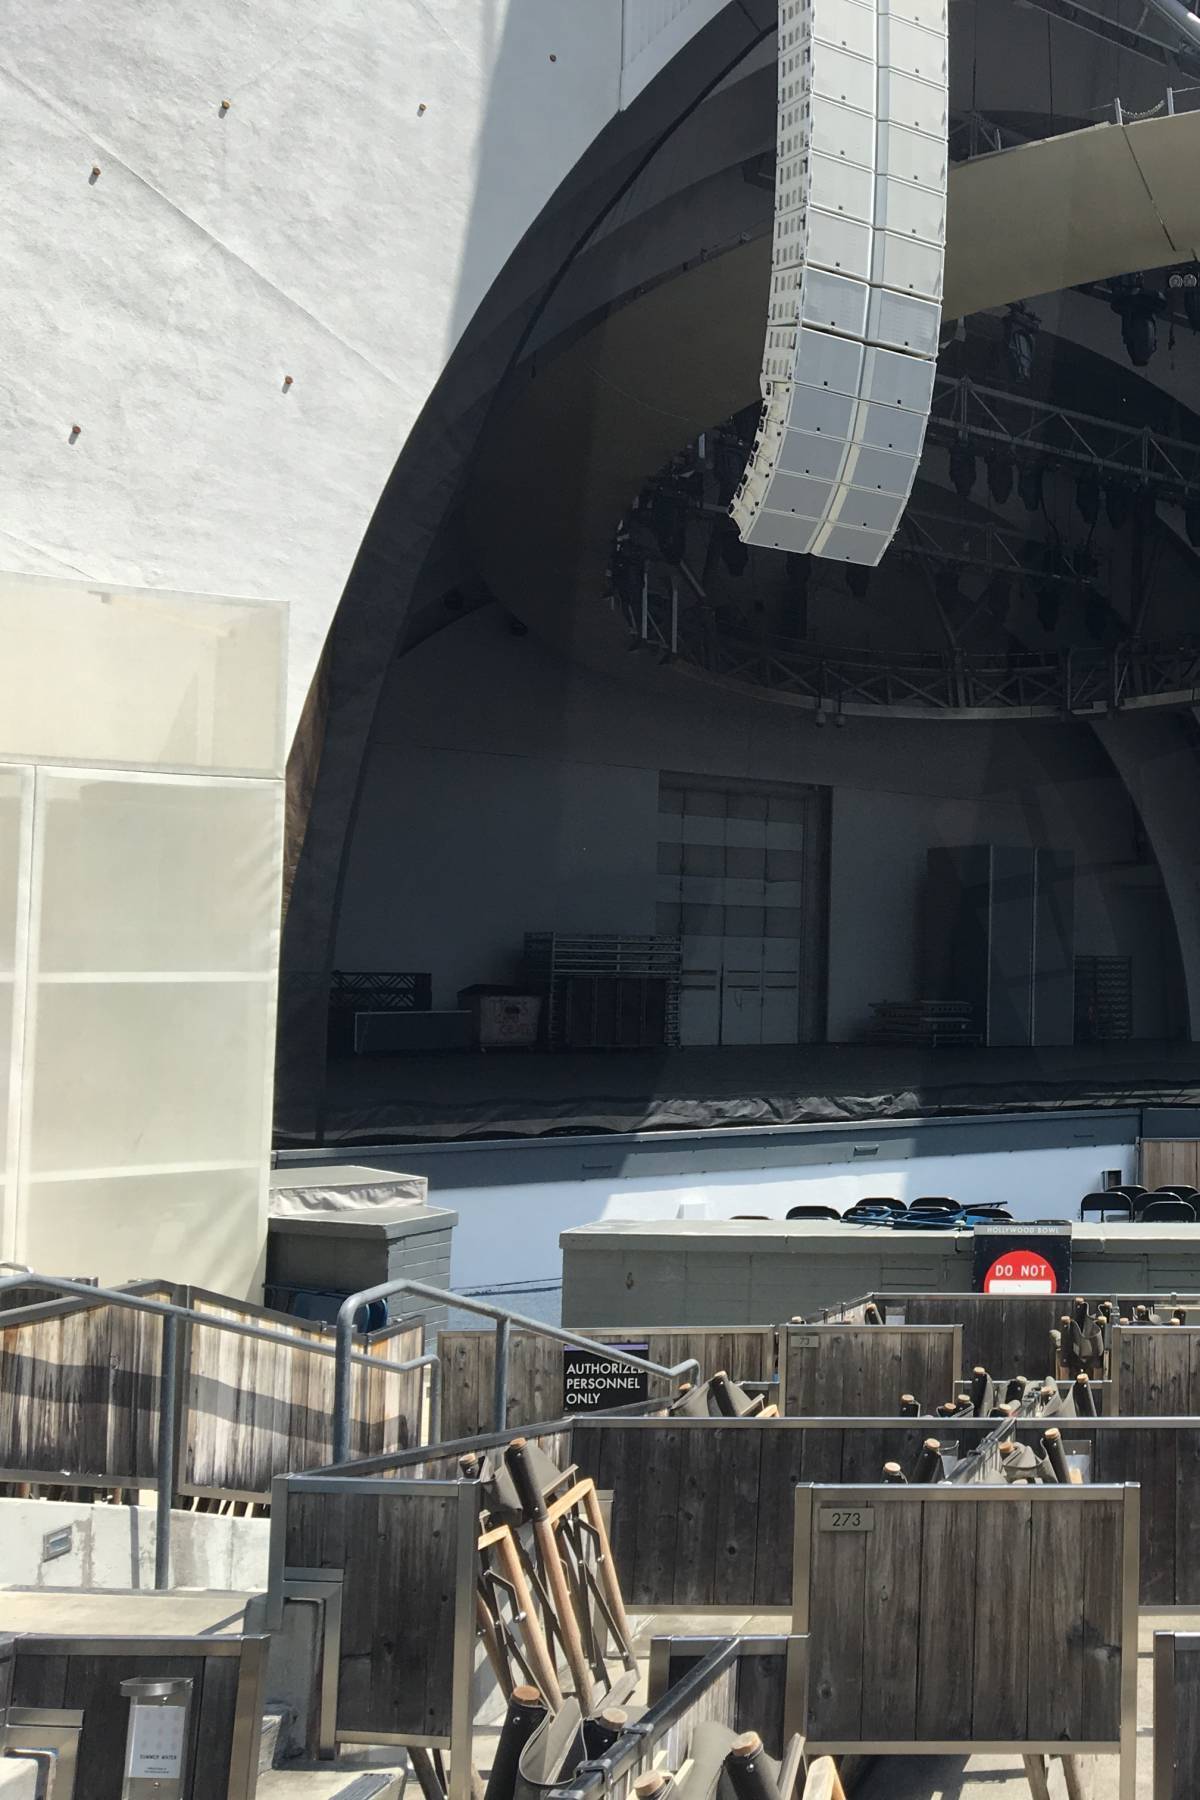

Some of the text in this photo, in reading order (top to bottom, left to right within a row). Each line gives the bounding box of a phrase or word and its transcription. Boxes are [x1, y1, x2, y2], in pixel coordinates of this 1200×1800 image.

[995, 1265, 1047, 1277] DO NOT
[566, 1377, 640, 1390] PERSONNEL
[566, 1393, 600, 1404] ONLY
[832, 1512, 861, 1527] 273
